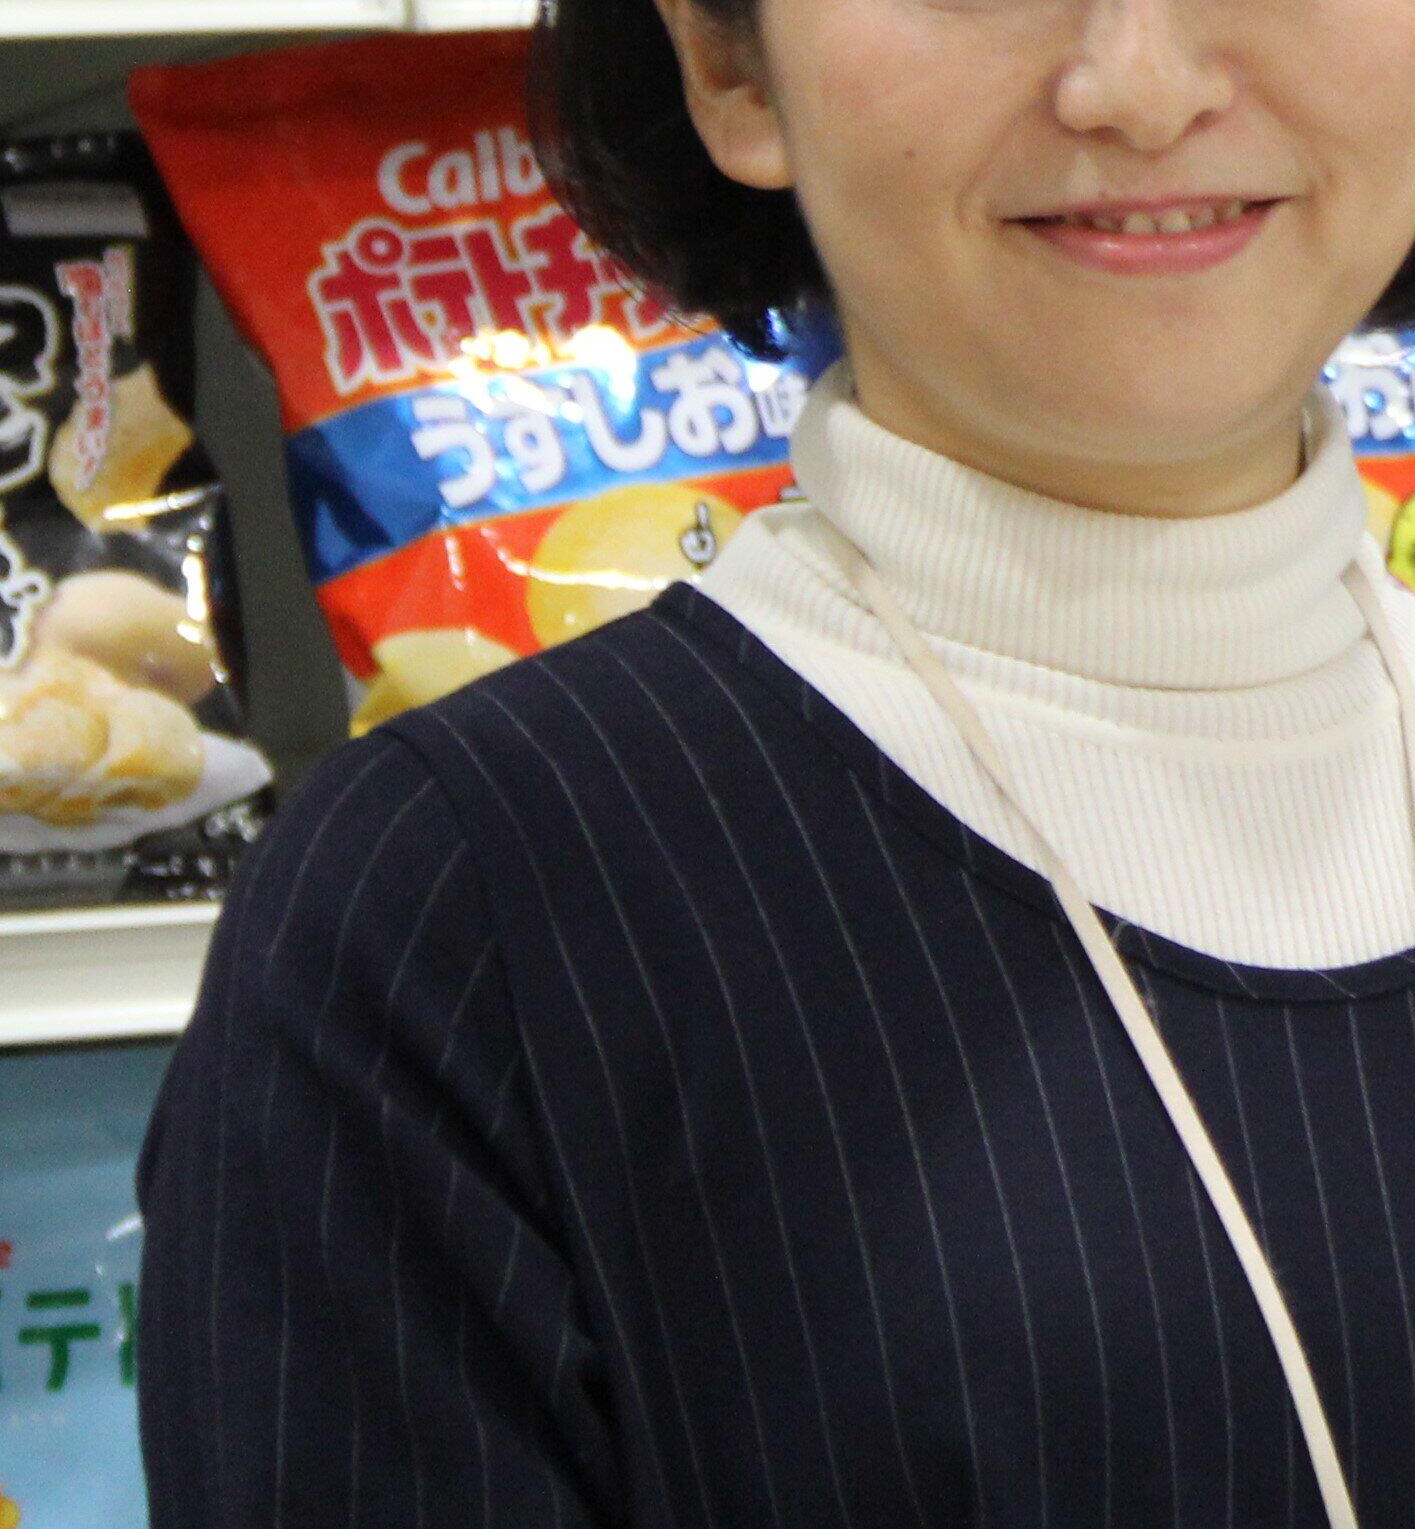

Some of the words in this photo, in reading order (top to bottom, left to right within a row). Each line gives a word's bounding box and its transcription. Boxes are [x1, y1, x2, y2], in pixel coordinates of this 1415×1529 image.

[376, 130, 548, 214] Calb
[308, 212, 700, 398] ポテトチ
